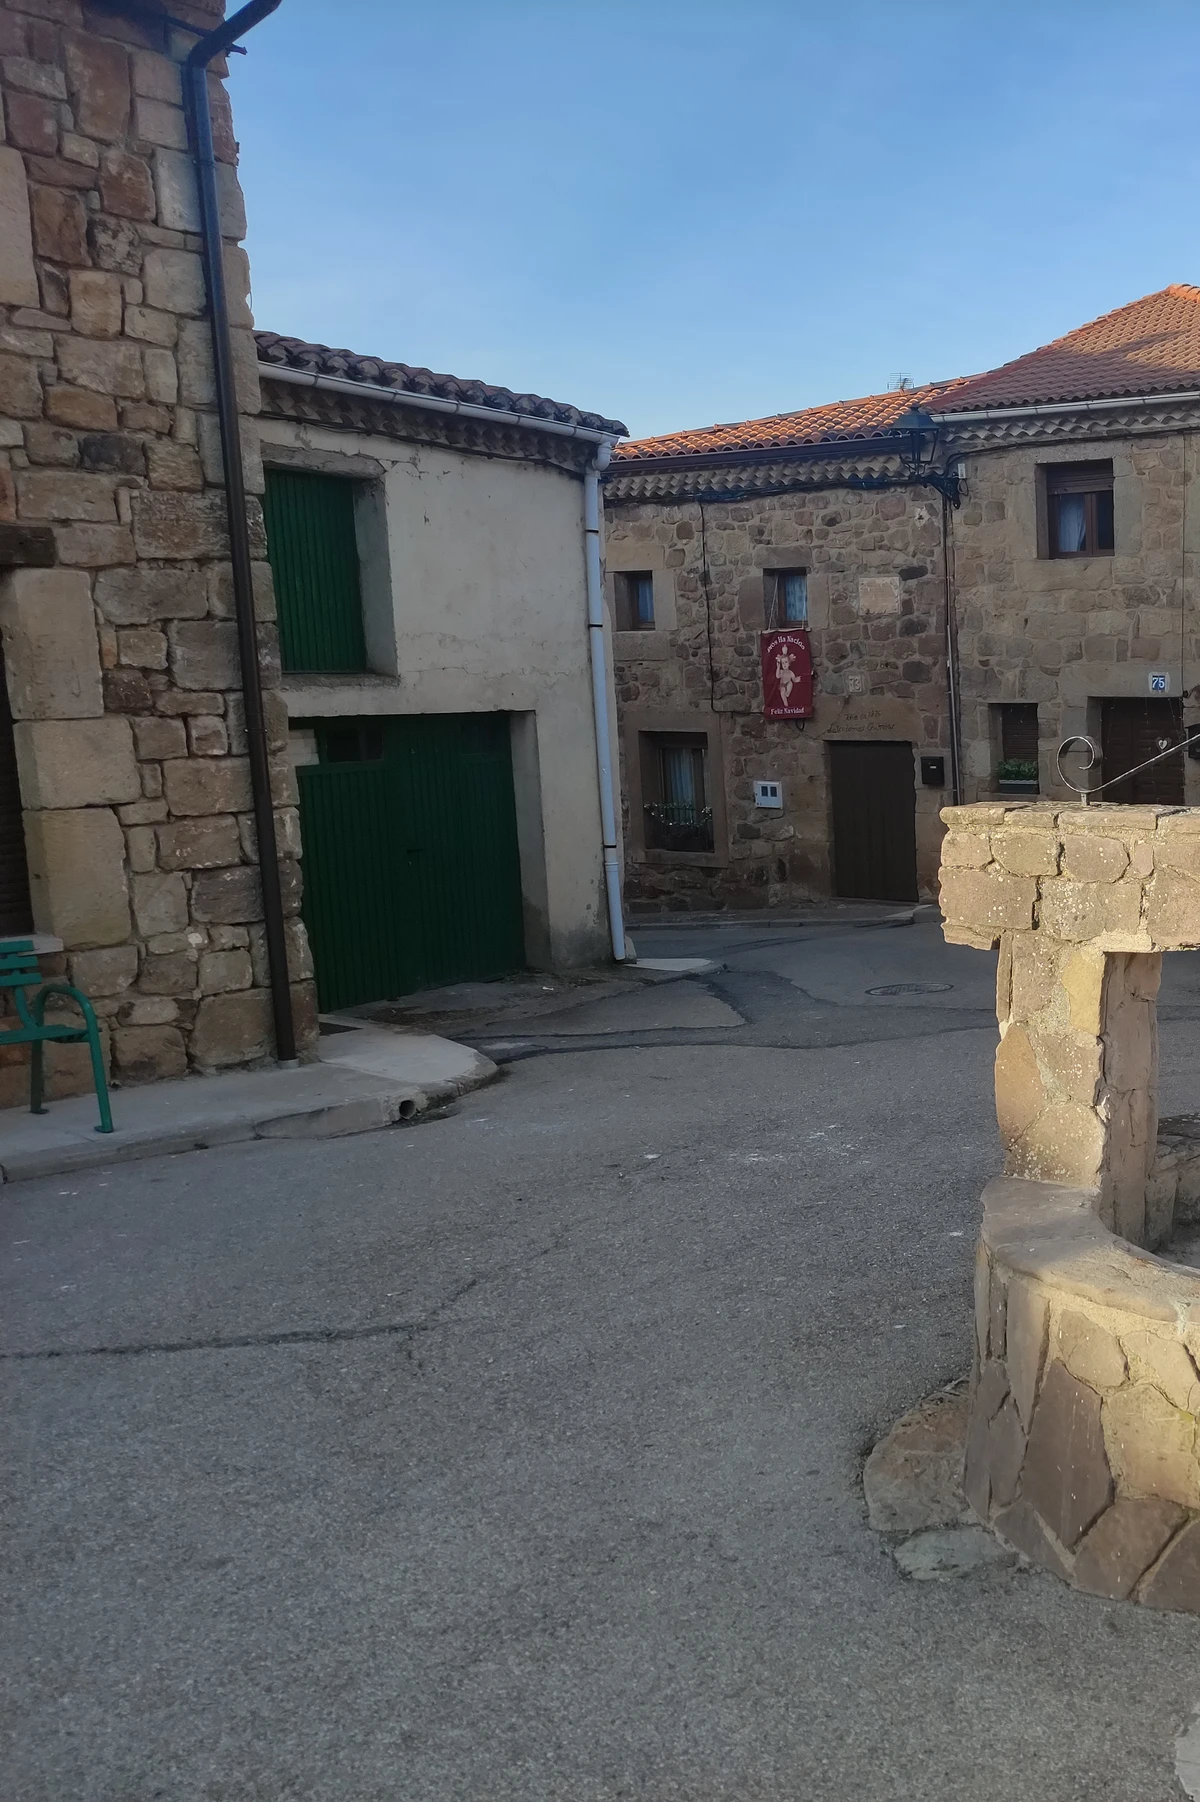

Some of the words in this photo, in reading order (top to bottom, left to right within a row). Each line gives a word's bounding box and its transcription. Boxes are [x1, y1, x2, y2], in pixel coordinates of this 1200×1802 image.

[1152, 677, 1165, 689] 75
[770, 707, 783, 715] Feliz
[783, 706, 805, 715] Navidad
